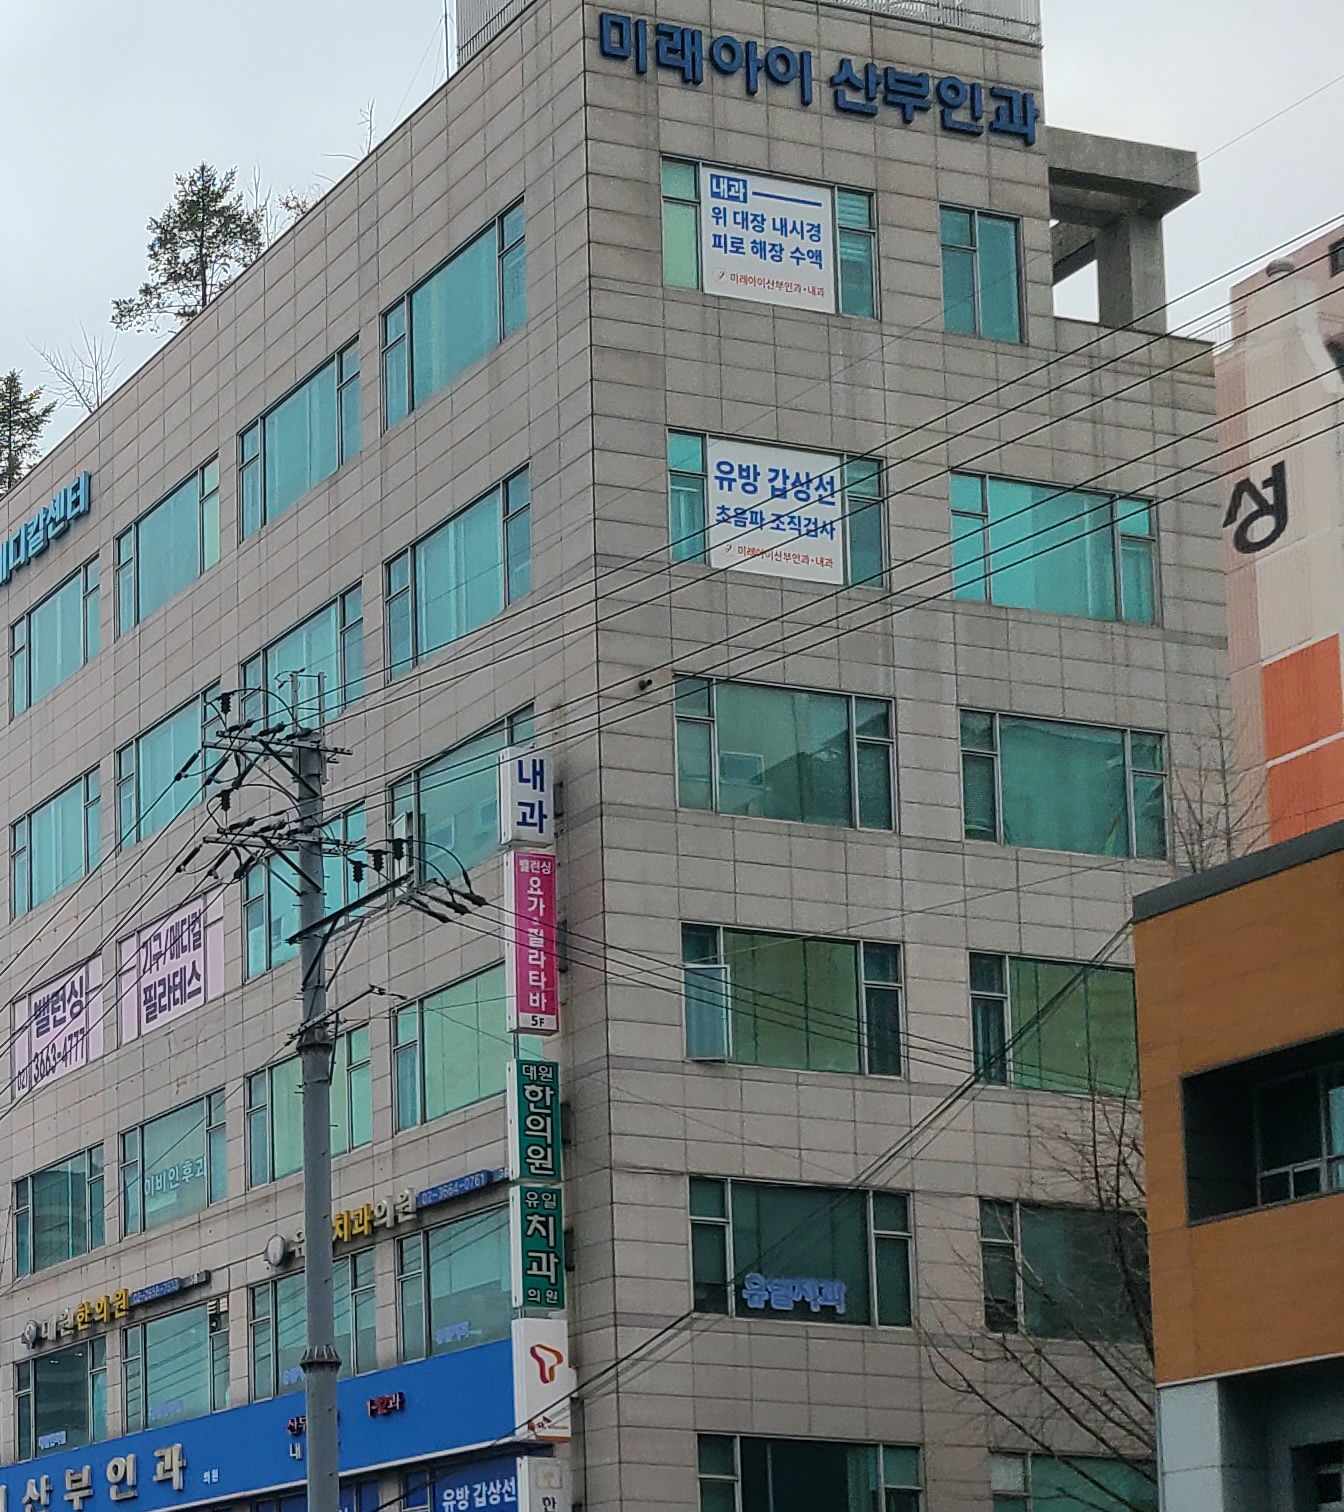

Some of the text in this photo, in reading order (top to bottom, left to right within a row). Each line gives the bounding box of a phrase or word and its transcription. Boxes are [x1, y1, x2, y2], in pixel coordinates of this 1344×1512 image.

[598, 12, 1039, 144] 미래아이 산부인과
[712, 176, 746, 202] 내과
[711, 206, 822, 243] 위 대장 내시경
[711, 233, 823, 270] 피로 해장 수액
[714, 461, 836, 506] 유방 갑상선
[715, 505, 836, 541] 초음파 조직검사
[517, 758, 548, 834] 내과
[34, 976, 84, 1038] 밸런싱
[143, 960, 202, 1024] 필라테스
[531, 1015, 545, 1027] 5F
[522, 1065, 553, 1081] 대원
[524, 1084, 554, 1176] 한의원
[144, 1153, 206, 1197] 이비인후과
[525, 1191, 557, 1209] 유일
[526, 1214, 559, 1284] 치과
[527, 1289, 558, 1304] 의원
[443, 1477, 516, 1512] 유방 갑상선
